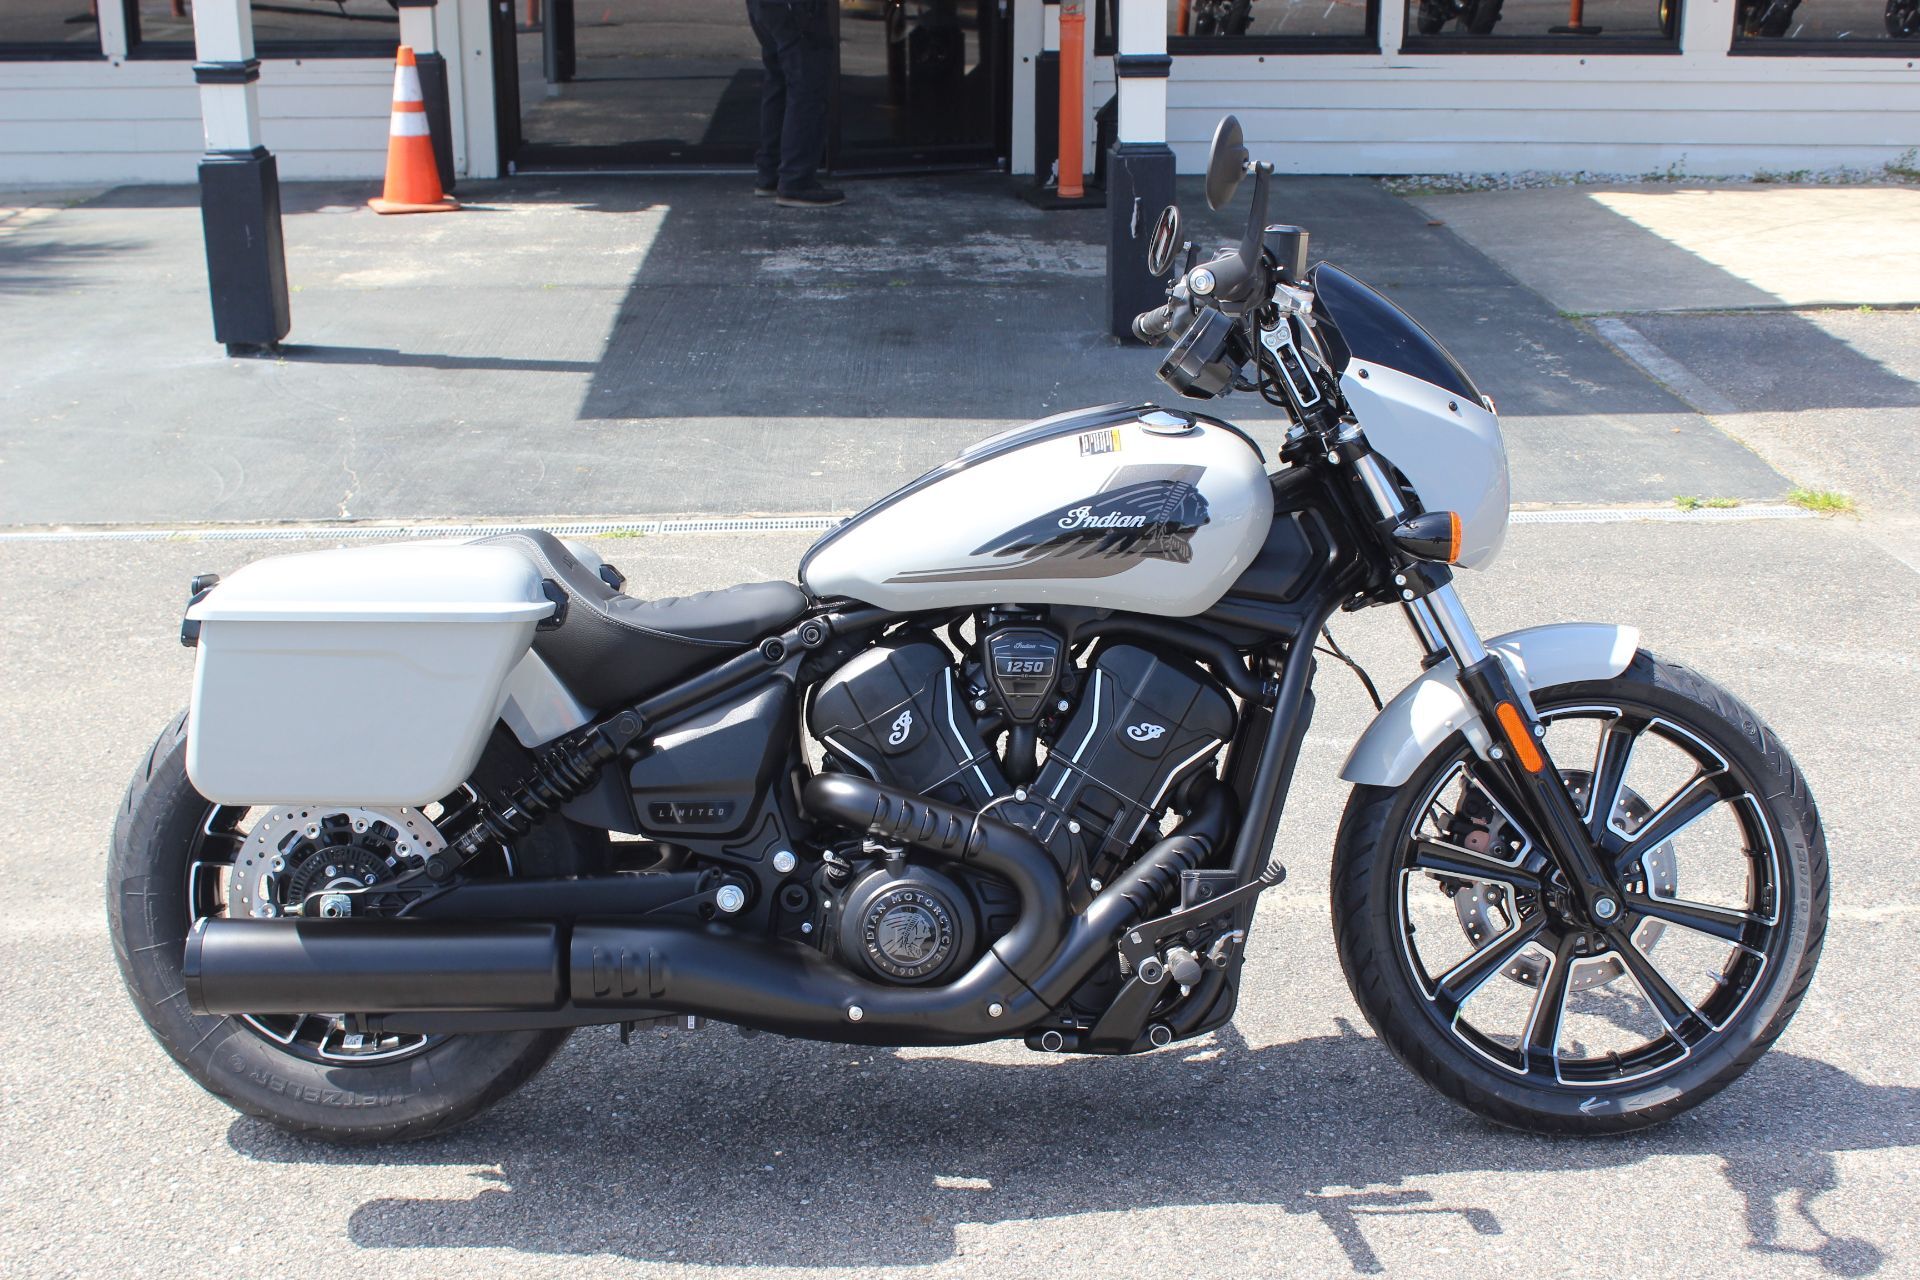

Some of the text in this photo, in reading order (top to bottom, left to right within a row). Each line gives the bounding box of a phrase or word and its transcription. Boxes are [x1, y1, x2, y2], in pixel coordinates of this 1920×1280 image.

[1058, 505, 1146, 529] Indian
[1006, 661, 1044, 673] 1250
[659, 808, 725, 817] LIMITED
[866, 892, 951, 961] INDIAN MOTORCYCLE
[892, 966, 922, 976] 1901
